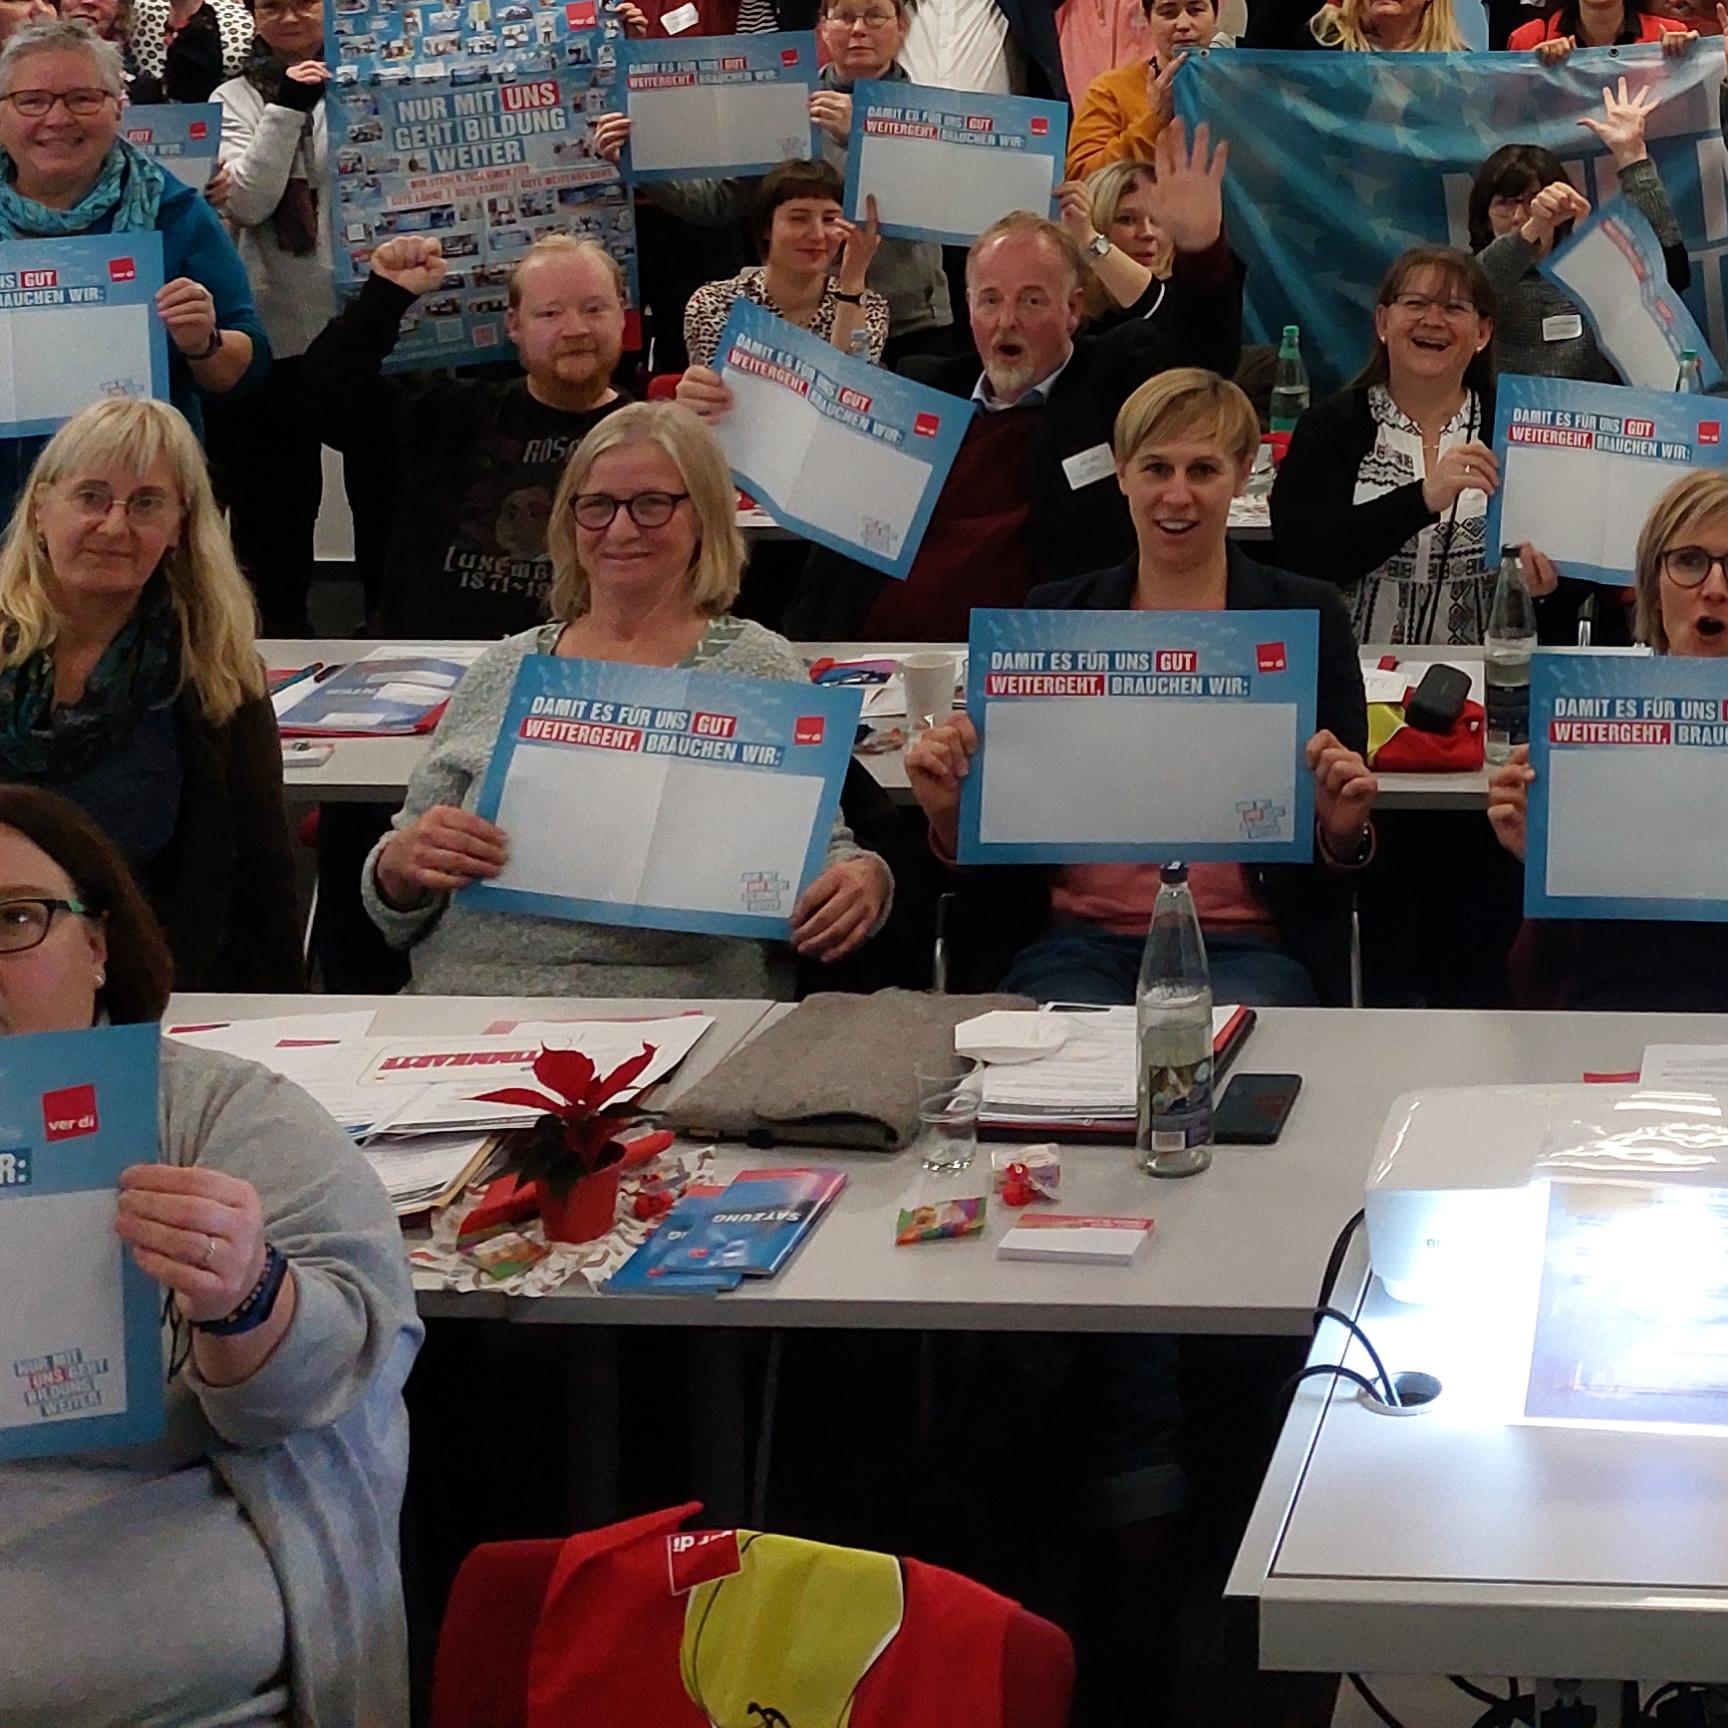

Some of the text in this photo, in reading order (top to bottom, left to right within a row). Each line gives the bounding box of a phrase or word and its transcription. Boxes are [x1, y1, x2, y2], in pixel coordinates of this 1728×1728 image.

[398, 83, 555, 122] NUR MIT UNS
[395, 108, 566, 150] GEHT BILDUNG
[867, 121, 936, 139] WEITERGEHT,
[969, 118, 990, 131] GUT
[433, 141, 521, 171] WEITER
[26, 271, 55, 287] GUT
[69, 287, 105, 301] WIR:
[736, 333, 774, 359] DAMIT
[776, 351, 794, 367] ES
[841, 390, 870, 411] GUT
[730, 351, 807, 396] WEITERGEHT,
[872, 421, 902, 442] WIR:
[1513, 408, 1551, 425] DAMIT
[1557, 412, 1571, 426] ES
[1628, 421, 1651, 435] GUT
[1512, 427, 1592, 448] WEITERGEHT,
[1661, 442, 1690, 460] WIR:
[991, 650, 1193, 671] DAMIT ES FÜR UNS GUT
[992, 676, 1248, 696] WEITERGEHT, BRAUCHEN WIR:
[531, 696, 732, 736] DAMIT ES FÜR UNS GUT
[1555, 698, 1609, 717] DAMIT
[1615, 699, 1636, 717] ES
[1643, 698, 1675, 718] FÜR
[1681, 701, 1715, 720] UNS
[525, 720, 780, 764] WEITERGEHT, BRAUCHEN WIR:
[1555, 724, 1668, 744] WEITERGEHT,
[712, 1211, 801, 1224] SATZUNG
[33, 1368, 64, 1387] UNS
